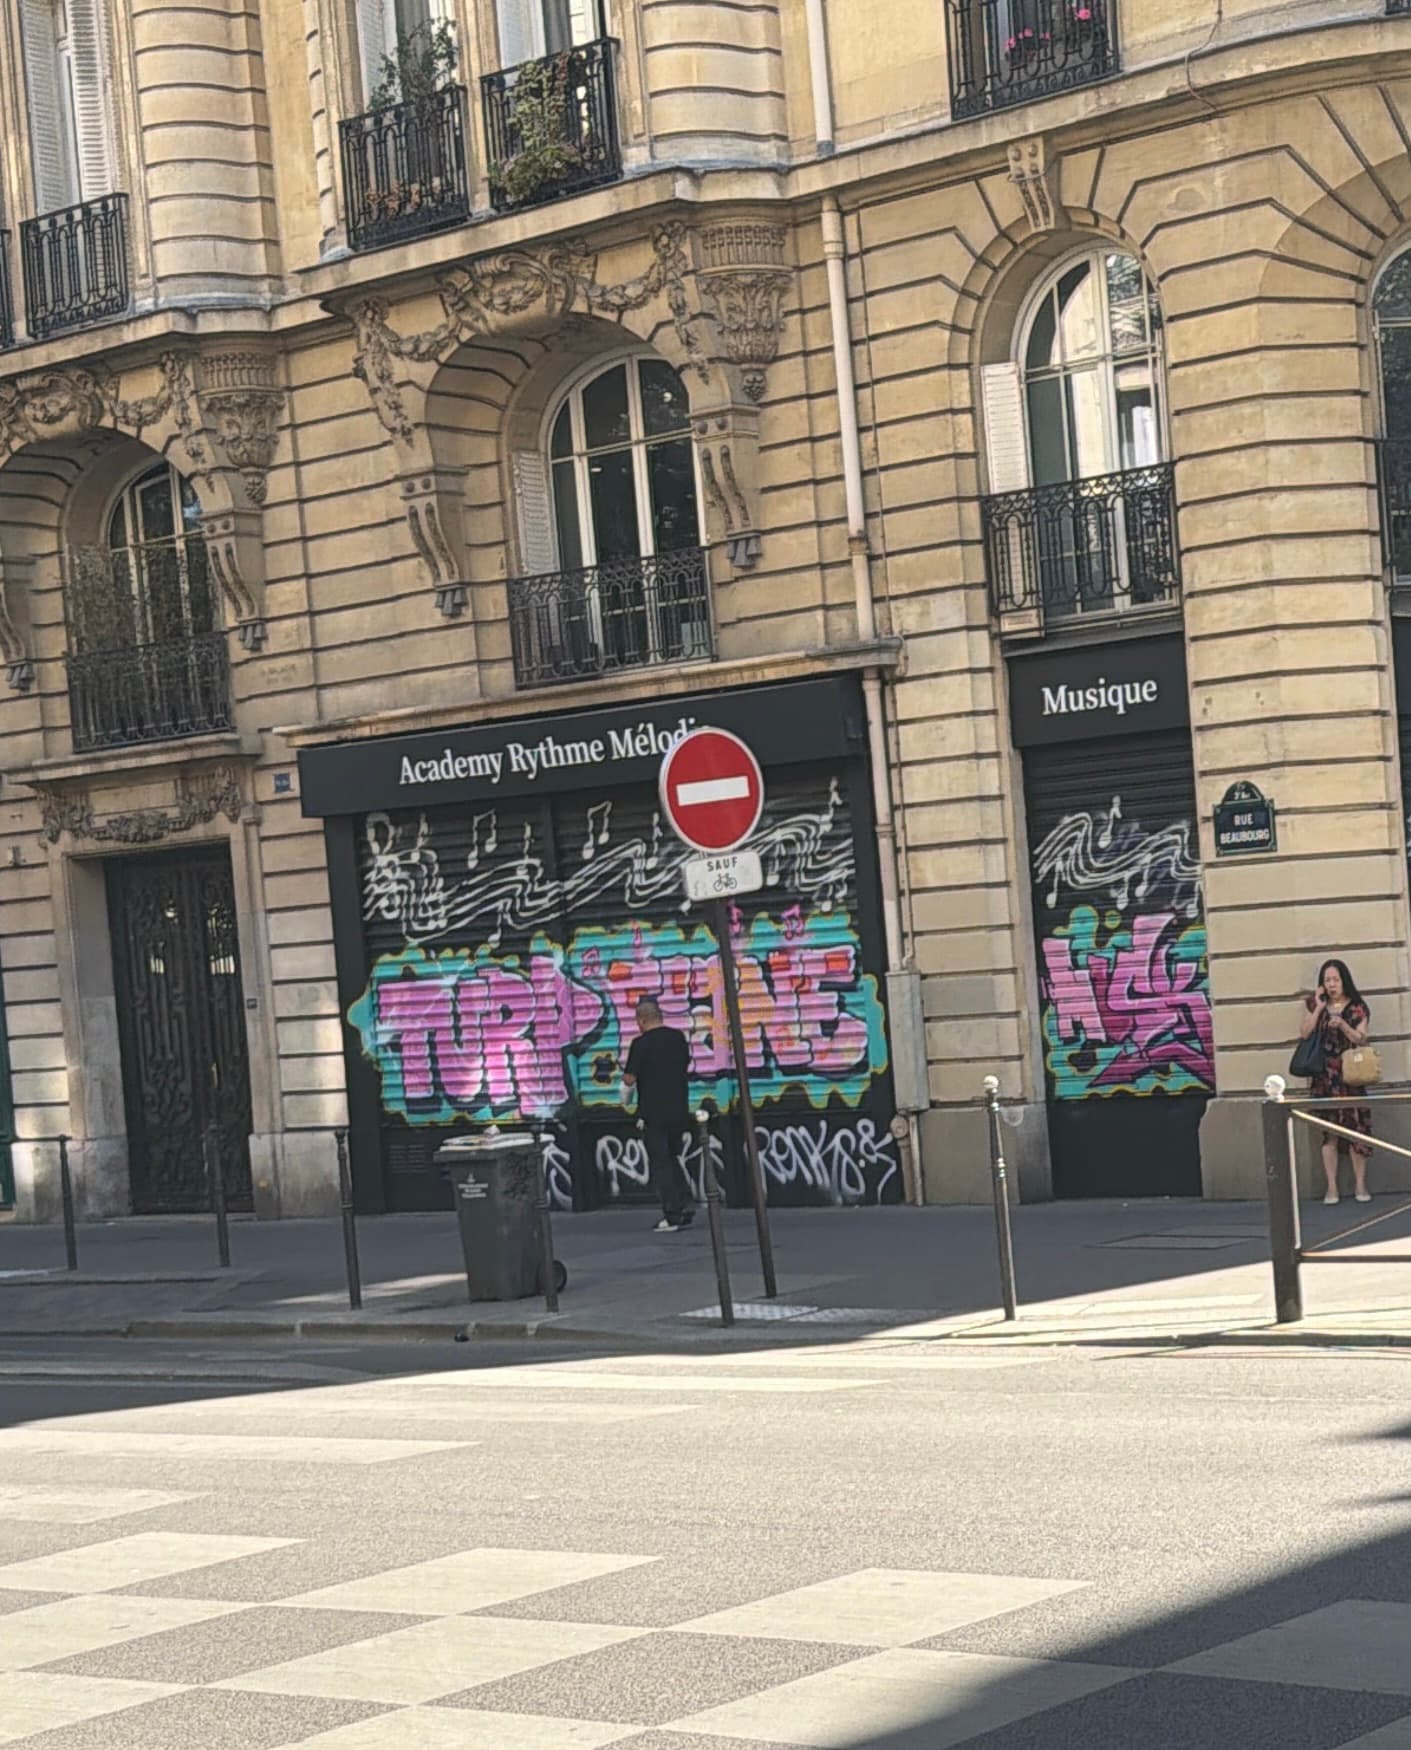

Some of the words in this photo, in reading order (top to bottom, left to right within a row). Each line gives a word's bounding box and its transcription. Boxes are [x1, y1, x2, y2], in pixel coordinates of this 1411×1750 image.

[1041, 677, 1158, 716] Musique
[399, 749, 503, 785] Academy
[507, 736, 606, 780] Rythme
[607, 717, 712, 760] Mélod
[1233, 812, 1254, 827] RUE
[1219, 827, 1271, 845] BEAUBOURG
[706, 856, 738, 872] SAUF
